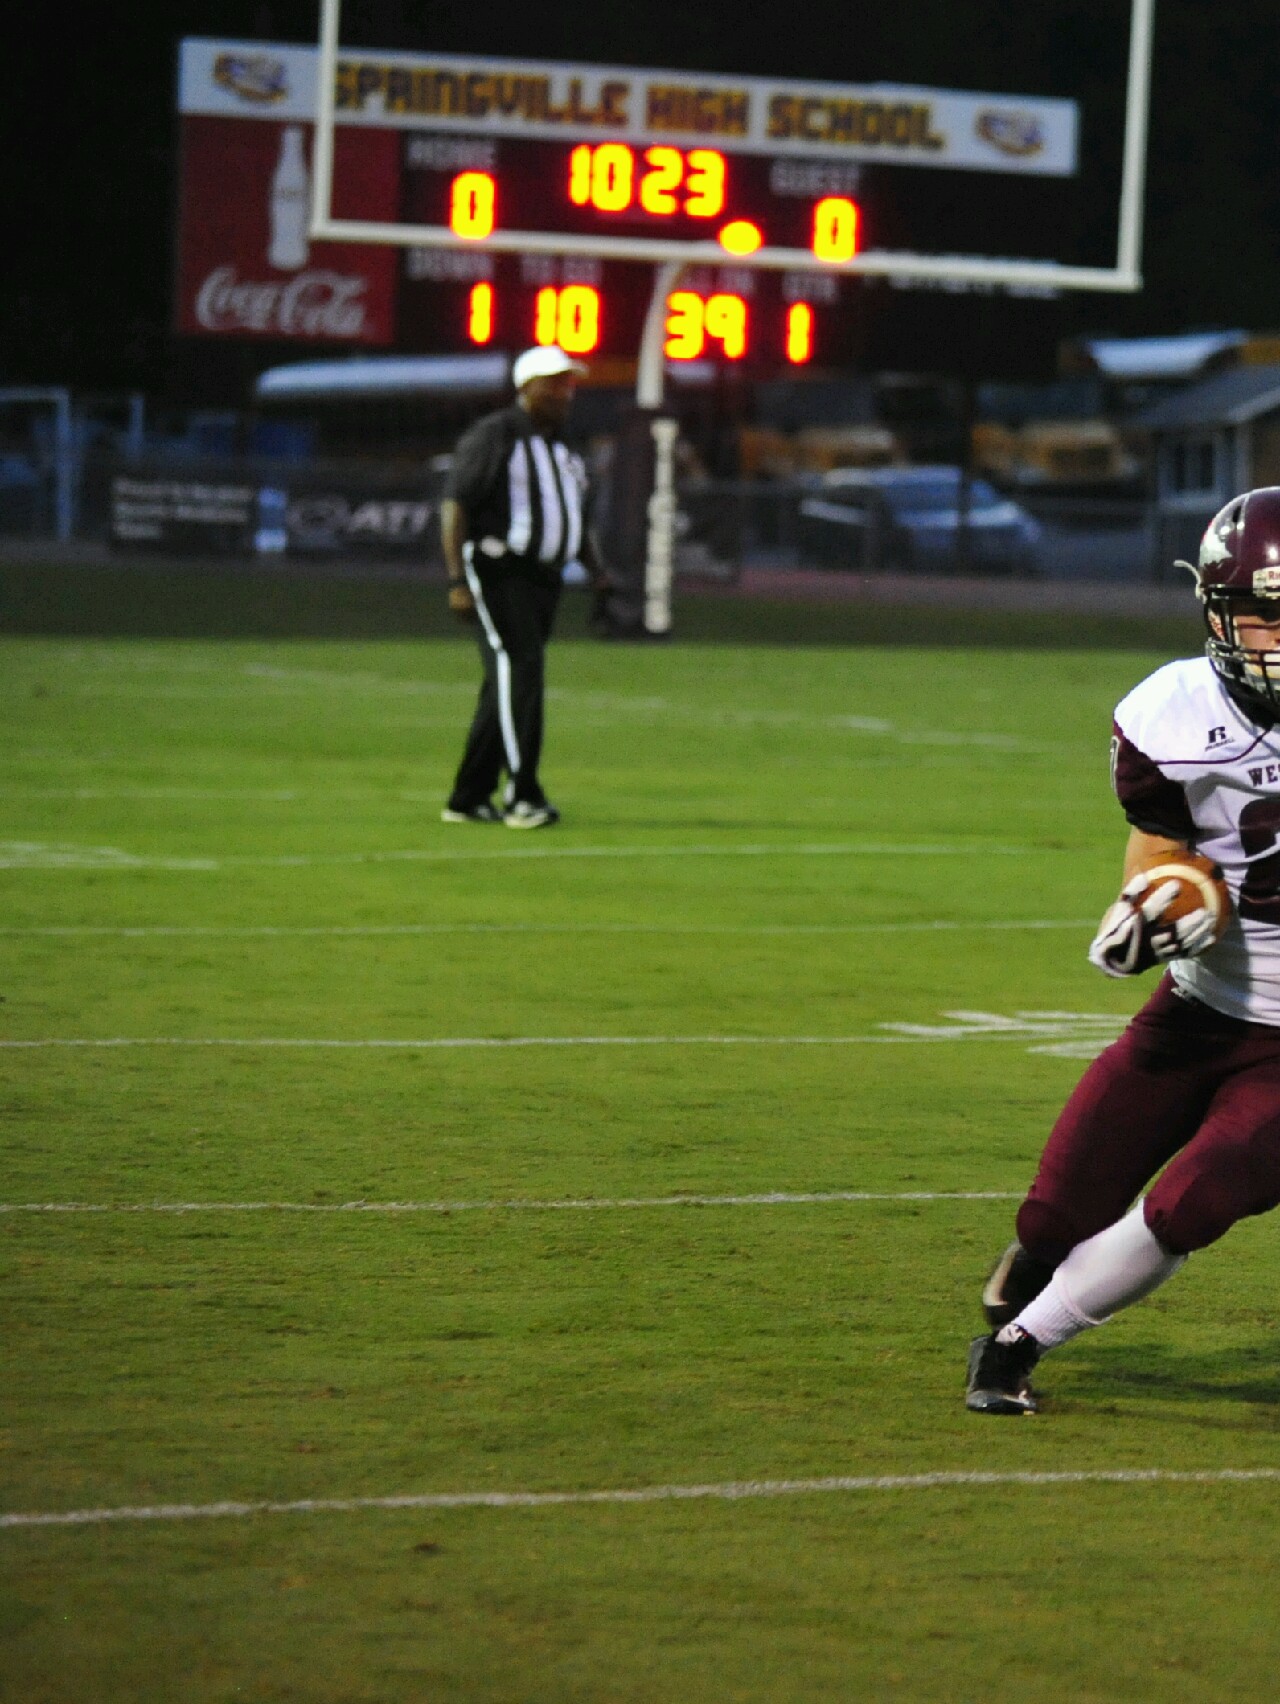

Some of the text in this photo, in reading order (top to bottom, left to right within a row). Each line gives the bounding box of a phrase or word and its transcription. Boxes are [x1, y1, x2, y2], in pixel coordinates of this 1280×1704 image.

[647, 85, 749, 136] HIGH
[766, 95, 945, 150] SCHOOL
[450, 172, 495, 240] 0
[812, 197, 859, 263] 0
[535, 284, 600, 354] 10
[663, 290, 746, 360] 39
